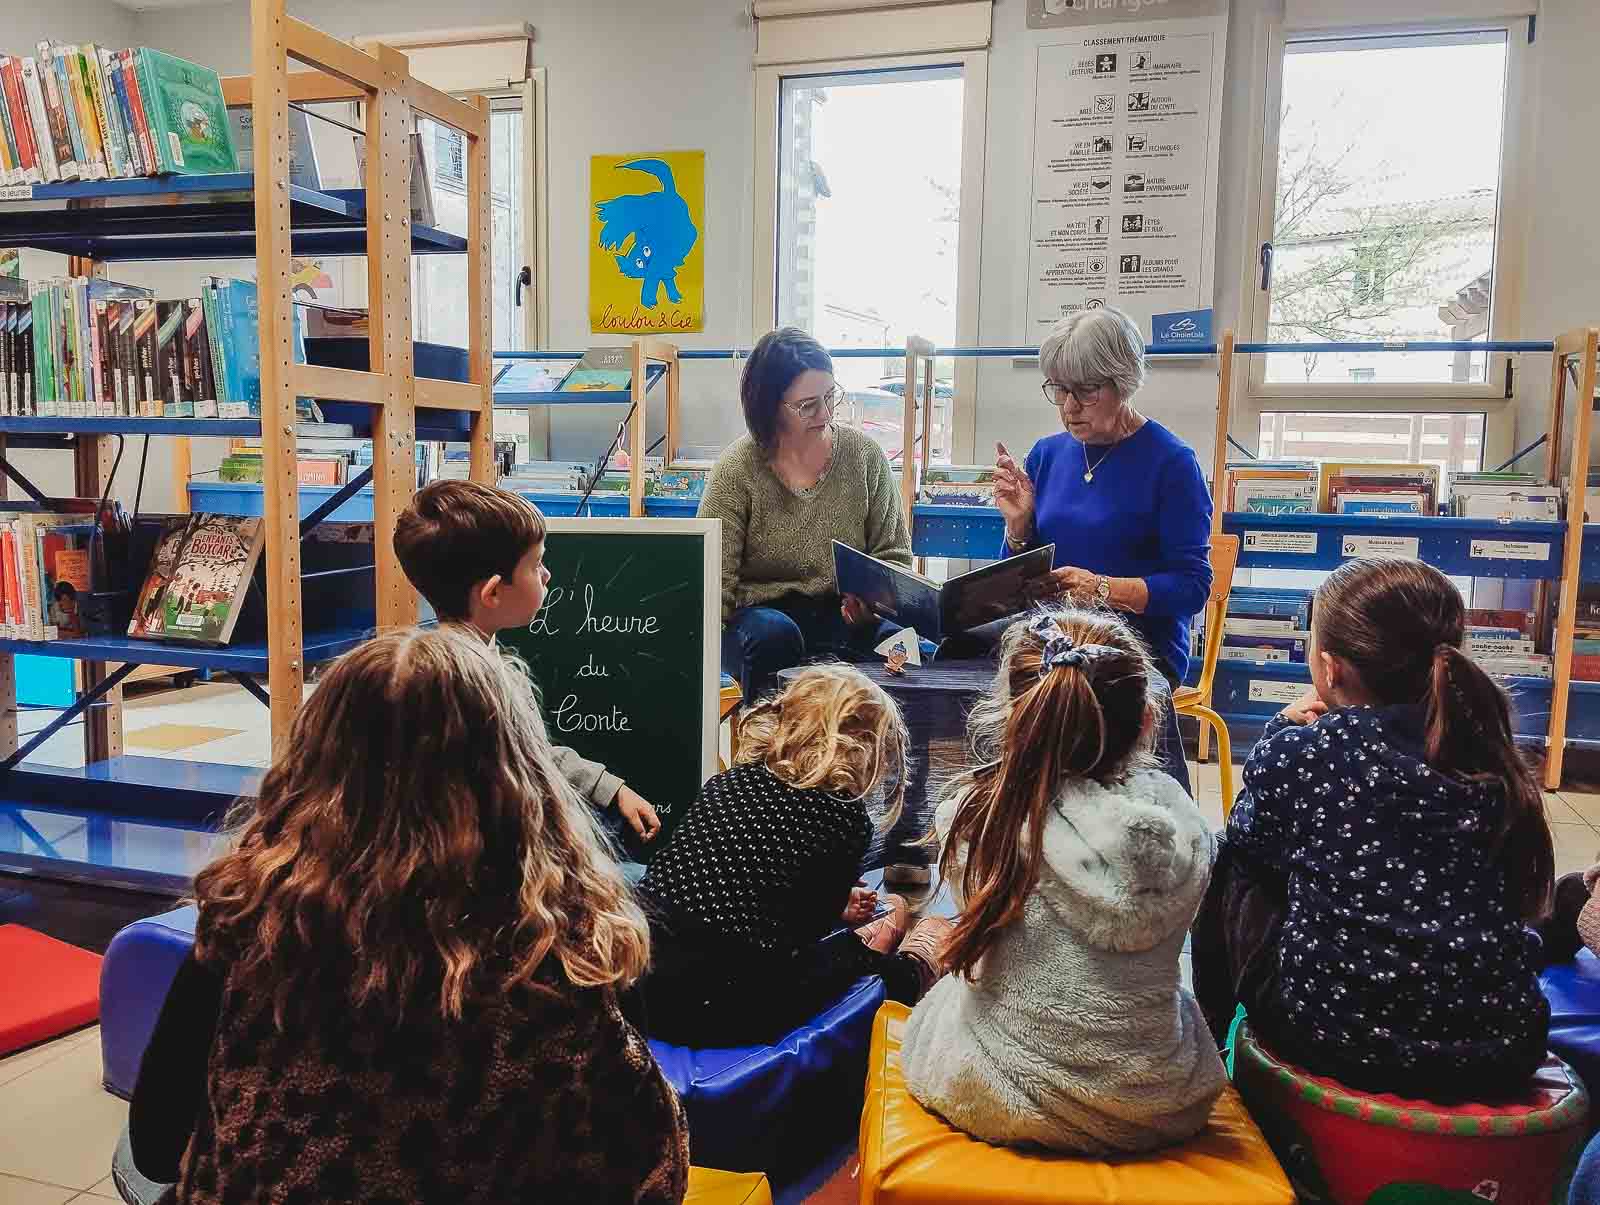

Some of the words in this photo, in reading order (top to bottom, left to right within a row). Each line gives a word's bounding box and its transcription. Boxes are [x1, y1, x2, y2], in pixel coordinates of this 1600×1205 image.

[1083, 37, 1125, 46] CLASSEMENT
[1126, 34, 1166, 44] THÉMATIQUE
[1152, 265, 1174, 273] GRANDS
[658, 312, 667, 327] &
[202, 534, 234, 545] ENFANTS
[191, 539, 231, 559] BOXCAR
[576, 653, 609, 677] du
[552, 694, 632, 732] Conte
